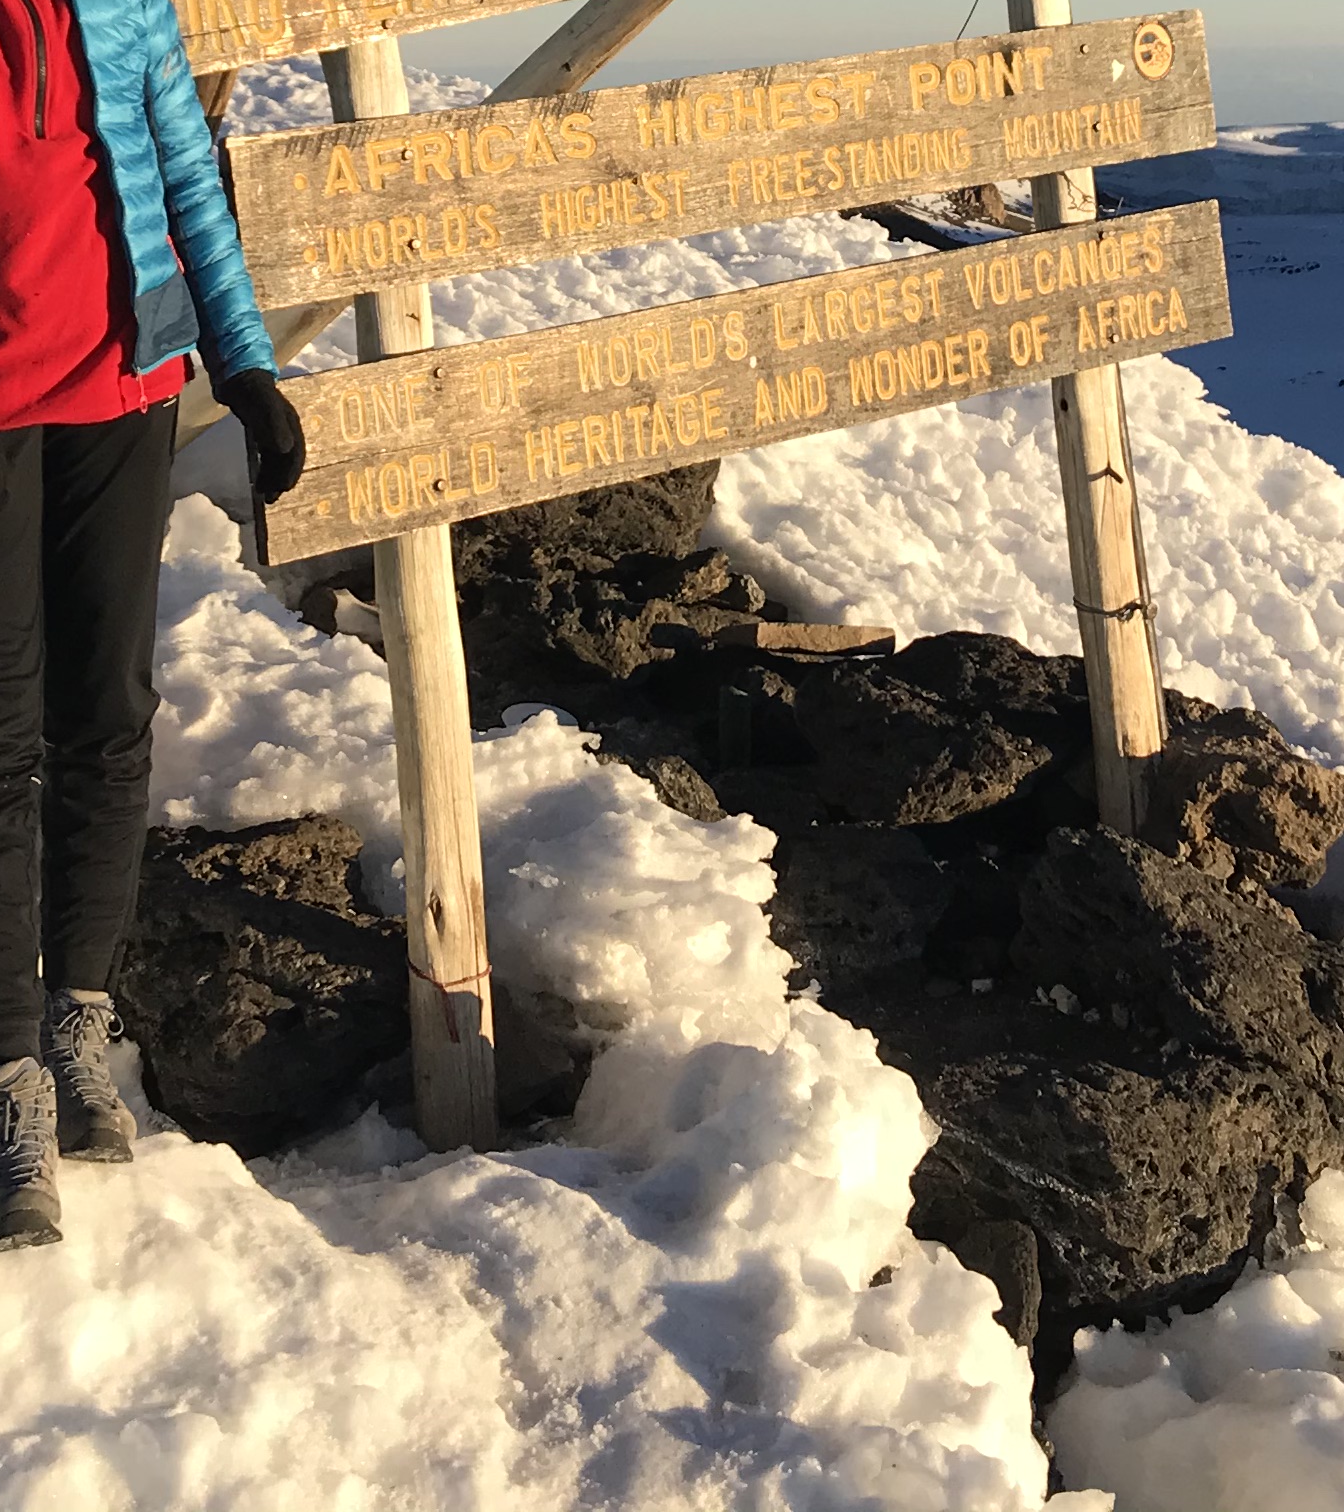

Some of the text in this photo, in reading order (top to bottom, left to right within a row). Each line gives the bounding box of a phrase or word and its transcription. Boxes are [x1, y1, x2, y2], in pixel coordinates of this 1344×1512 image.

[325, 203, 501, 275] WORLD'S
[539, 169, 692, 239] HIGHEST
[1003, 96, 1142, 161] MOUNTAIN
[638, 69, 878, 149] HIGHEST
[909, 46, 1053, 111] POINT
[338, 226, 1164, 445] ONE OF WORLD'S LARGEST VOLCANOES
[345, 287, 1189, 525] WORLD HERITAGE AND WONDER OF AFRICA
